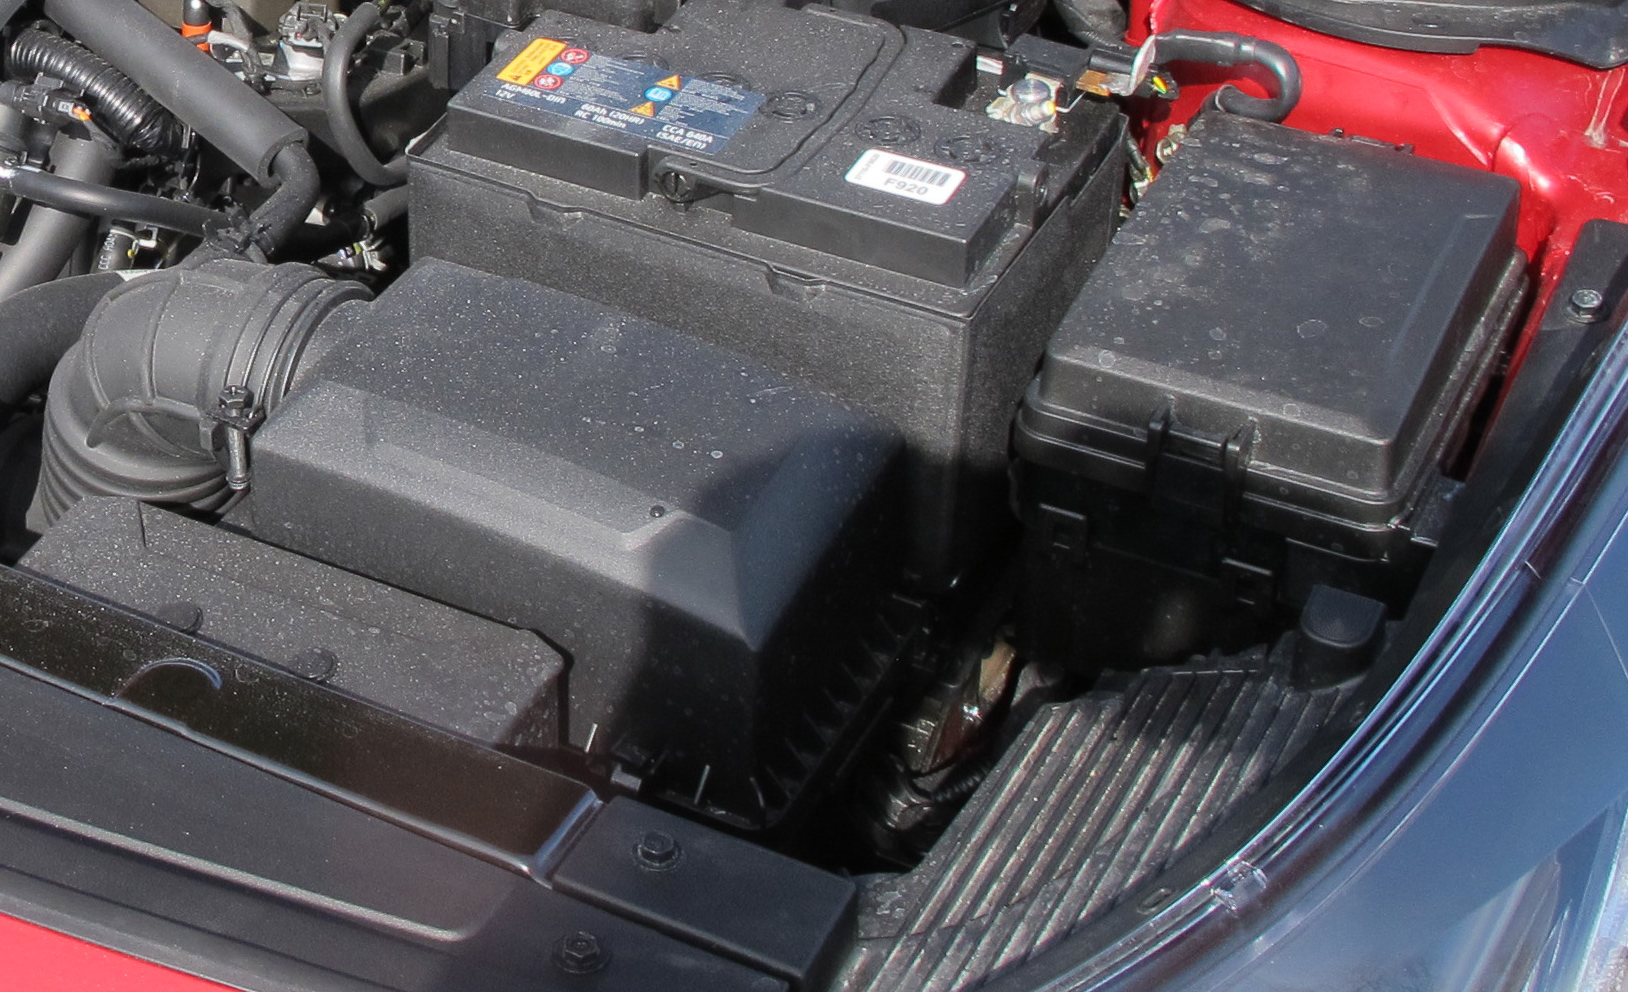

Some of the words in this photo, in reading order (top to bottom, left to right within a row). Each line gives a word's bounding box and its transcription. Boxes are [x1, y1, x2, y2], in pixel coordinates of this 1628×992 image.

[495, 89, 515, 99] 12V
[662, 124, 685, 136] CCA
[883, 177, 929, 196] F920
